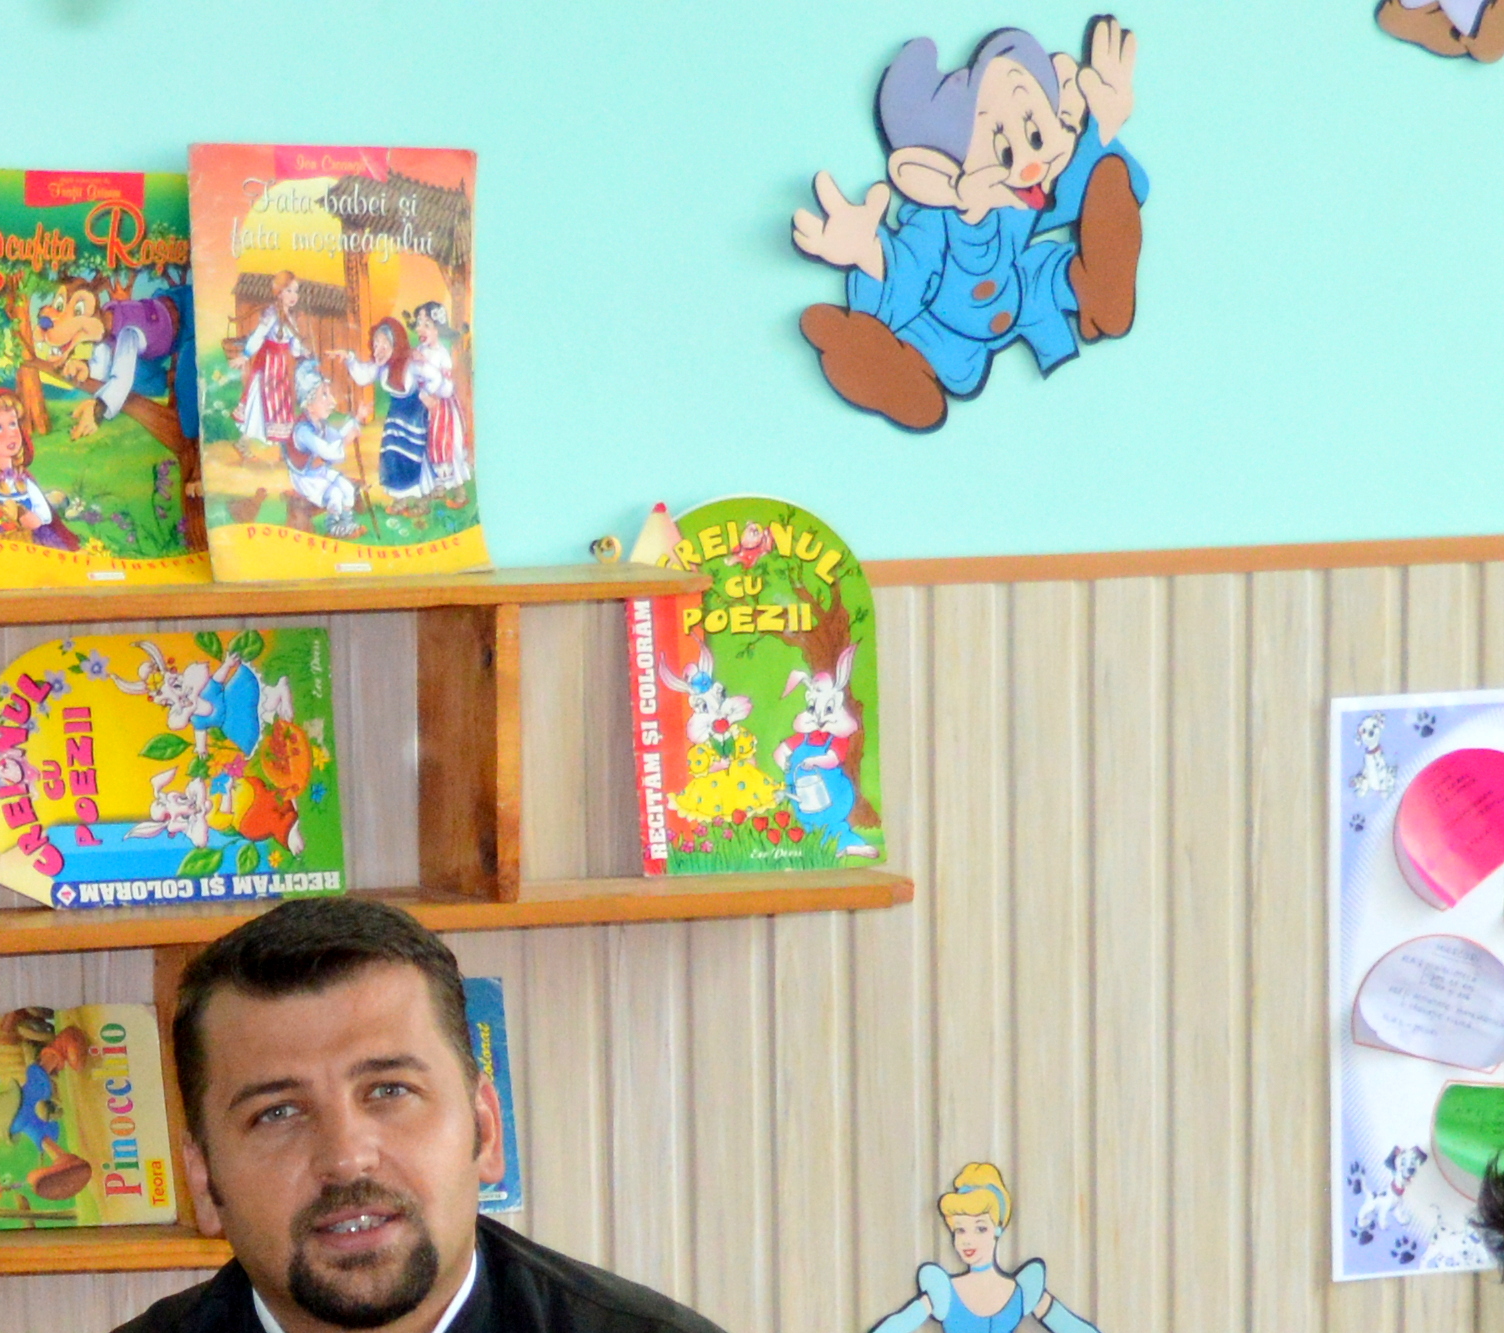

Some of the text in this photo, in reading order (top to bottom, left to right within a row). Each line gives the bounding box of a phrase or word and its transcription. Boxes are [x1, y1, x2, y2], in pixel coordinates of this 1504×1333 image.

[242, 177, 418, 224] Fata babei și
[230, 216, 434, 263] fata moșneagului
[110, 553, 209, 570] ilustrat
[724, 575, 763, 598] CU
[682, 602, 813, 636] POEZII
[633, 600, 668, 860] RECITĂM ȘI COLORĂM
[42, 759, 66, 801] CU
[62, 706, 103, 847] POEZII
[200, 873, 224, 897] ȘI
[233, 871, 340, 898] RECITĂM
[90, 1021, 145, 1198] Pinocchio
[150, 1160, 167, 1207] Teora
